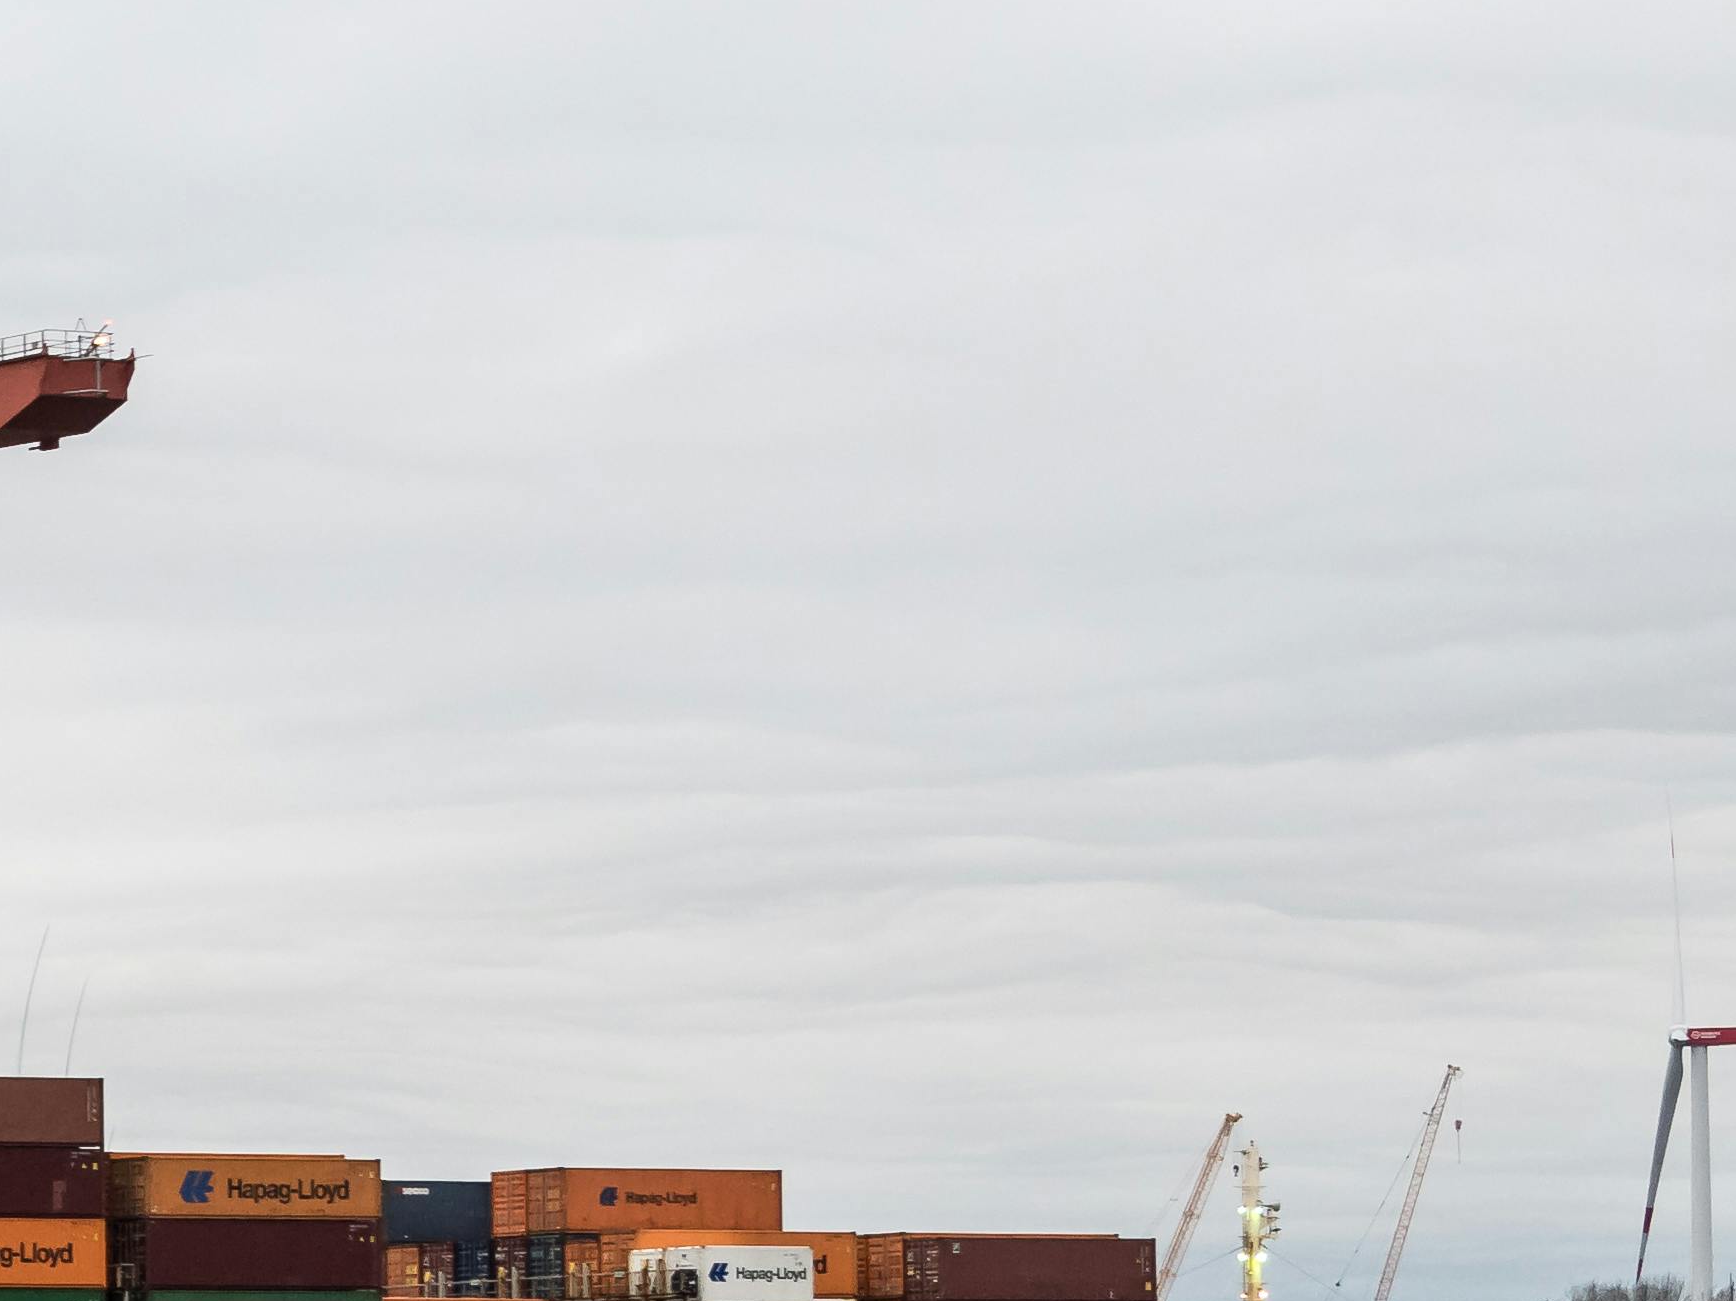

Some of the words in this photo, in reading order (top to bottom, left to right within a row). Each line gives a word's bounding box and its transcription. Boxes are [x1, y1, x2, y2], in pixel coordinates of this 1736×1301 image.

[227, 1178, 349, 1203] Hapag-Lloyd
[625, 1191, 697, 1206] Hapag-Lloyd
[736, 1267, 807, 1282] Hapag-Lloyd
